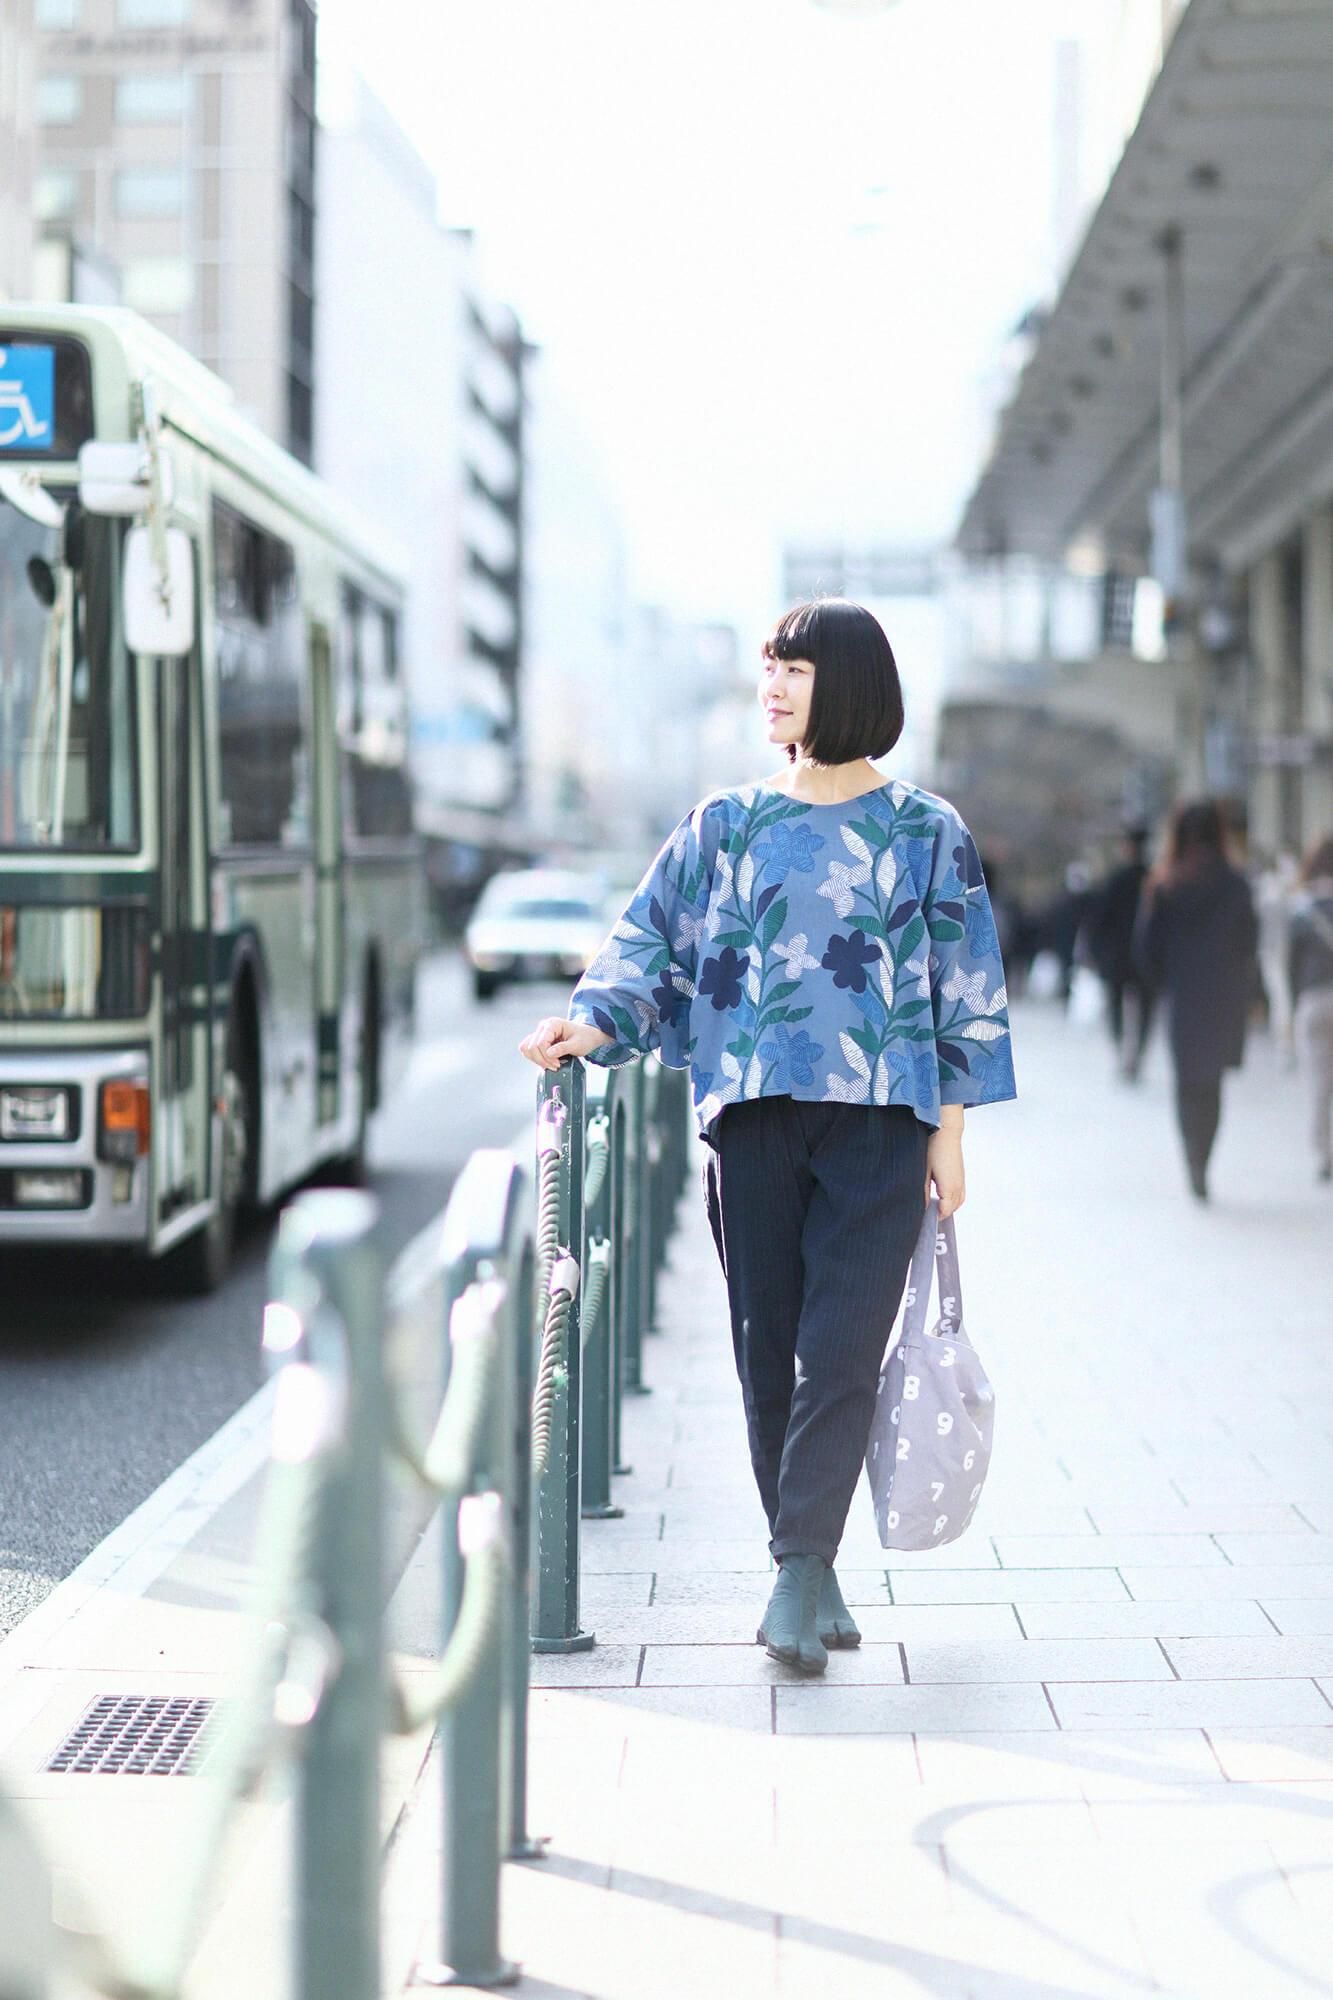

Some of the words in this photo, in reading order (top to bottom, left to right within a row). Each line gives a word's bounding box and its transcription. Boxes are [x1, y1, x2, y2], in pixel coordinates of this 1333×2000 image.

[940, 1347, 957, 1367] 3
[903, 1376, 921, 1401] 8
[937, 1413, 954, 1436] 9
[896, 1438, 911, 1461] 2
[964, 1450, 976, 1472] 6
[931, 1482, 945, 1503] 7
[888, 1511, 900, 1530] 0
[933, 1514, 949, 1536] 8
